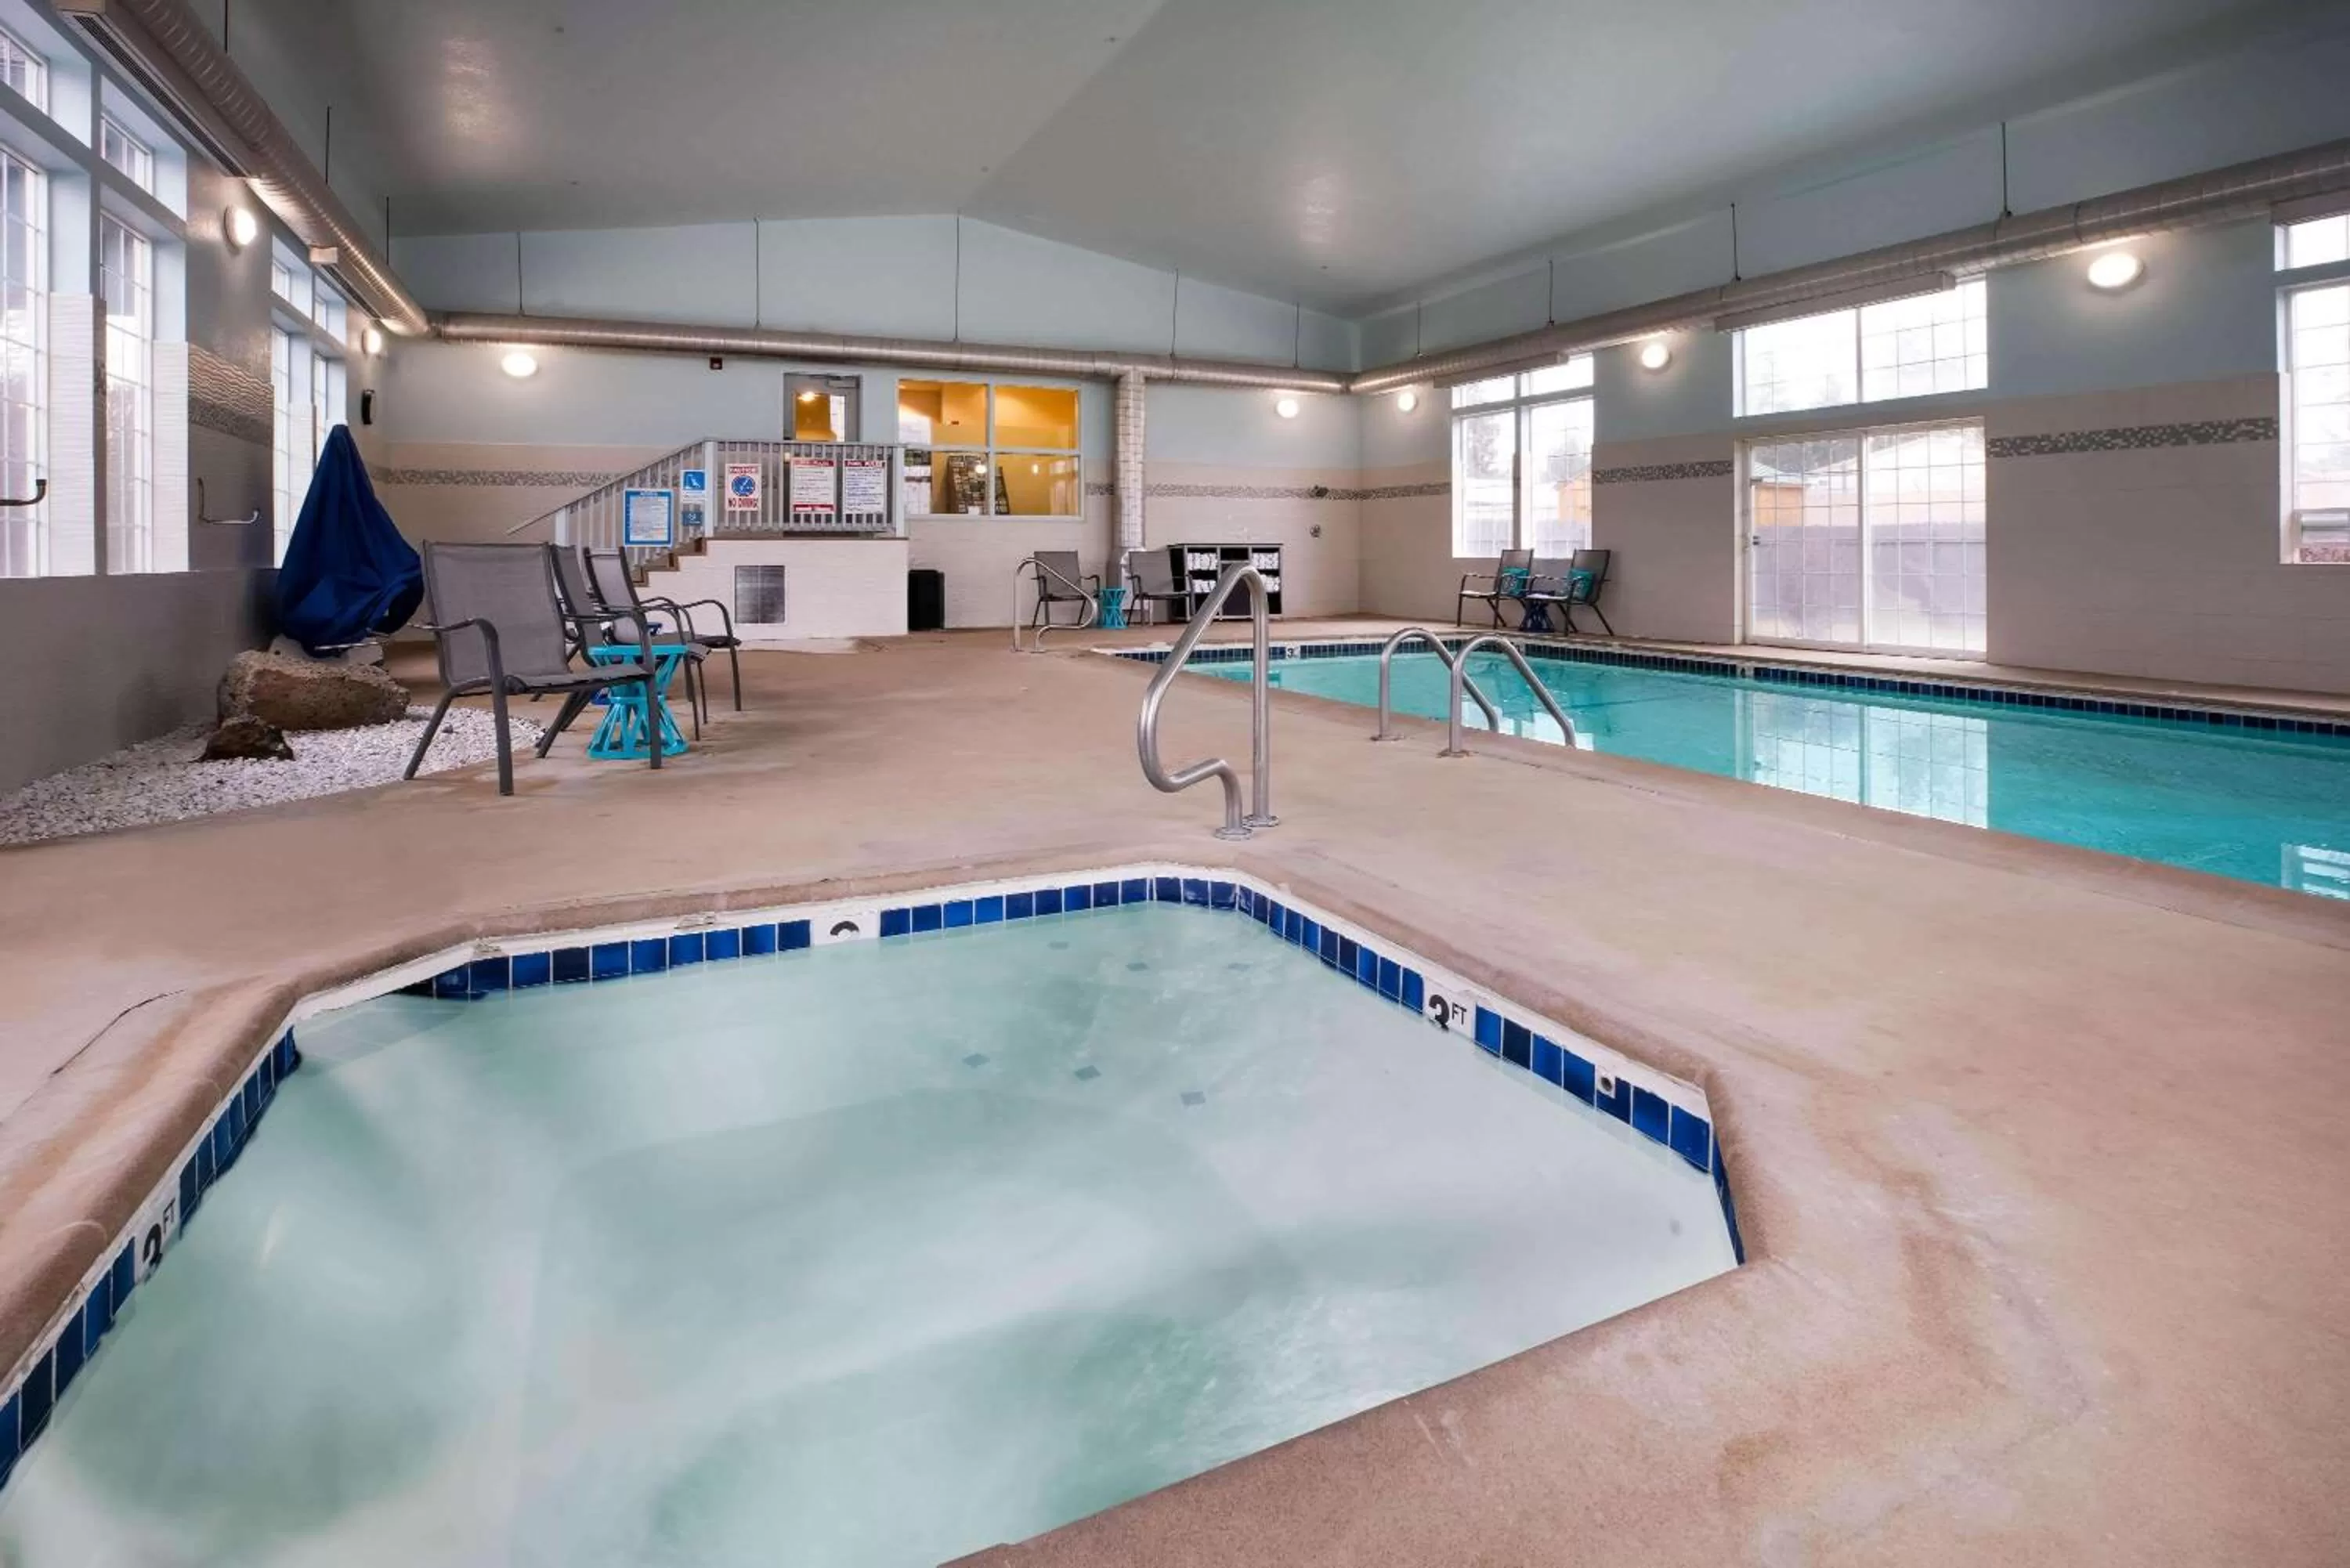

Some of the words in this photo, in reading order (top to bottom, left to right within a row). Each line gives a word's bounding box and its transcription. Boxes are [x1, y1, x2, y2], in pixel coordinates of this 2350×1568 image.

[728, 497, 736, 508] NO
[1452, 1002, 1467, 1025] FT
[163, 1197, 175, 1234] FT
